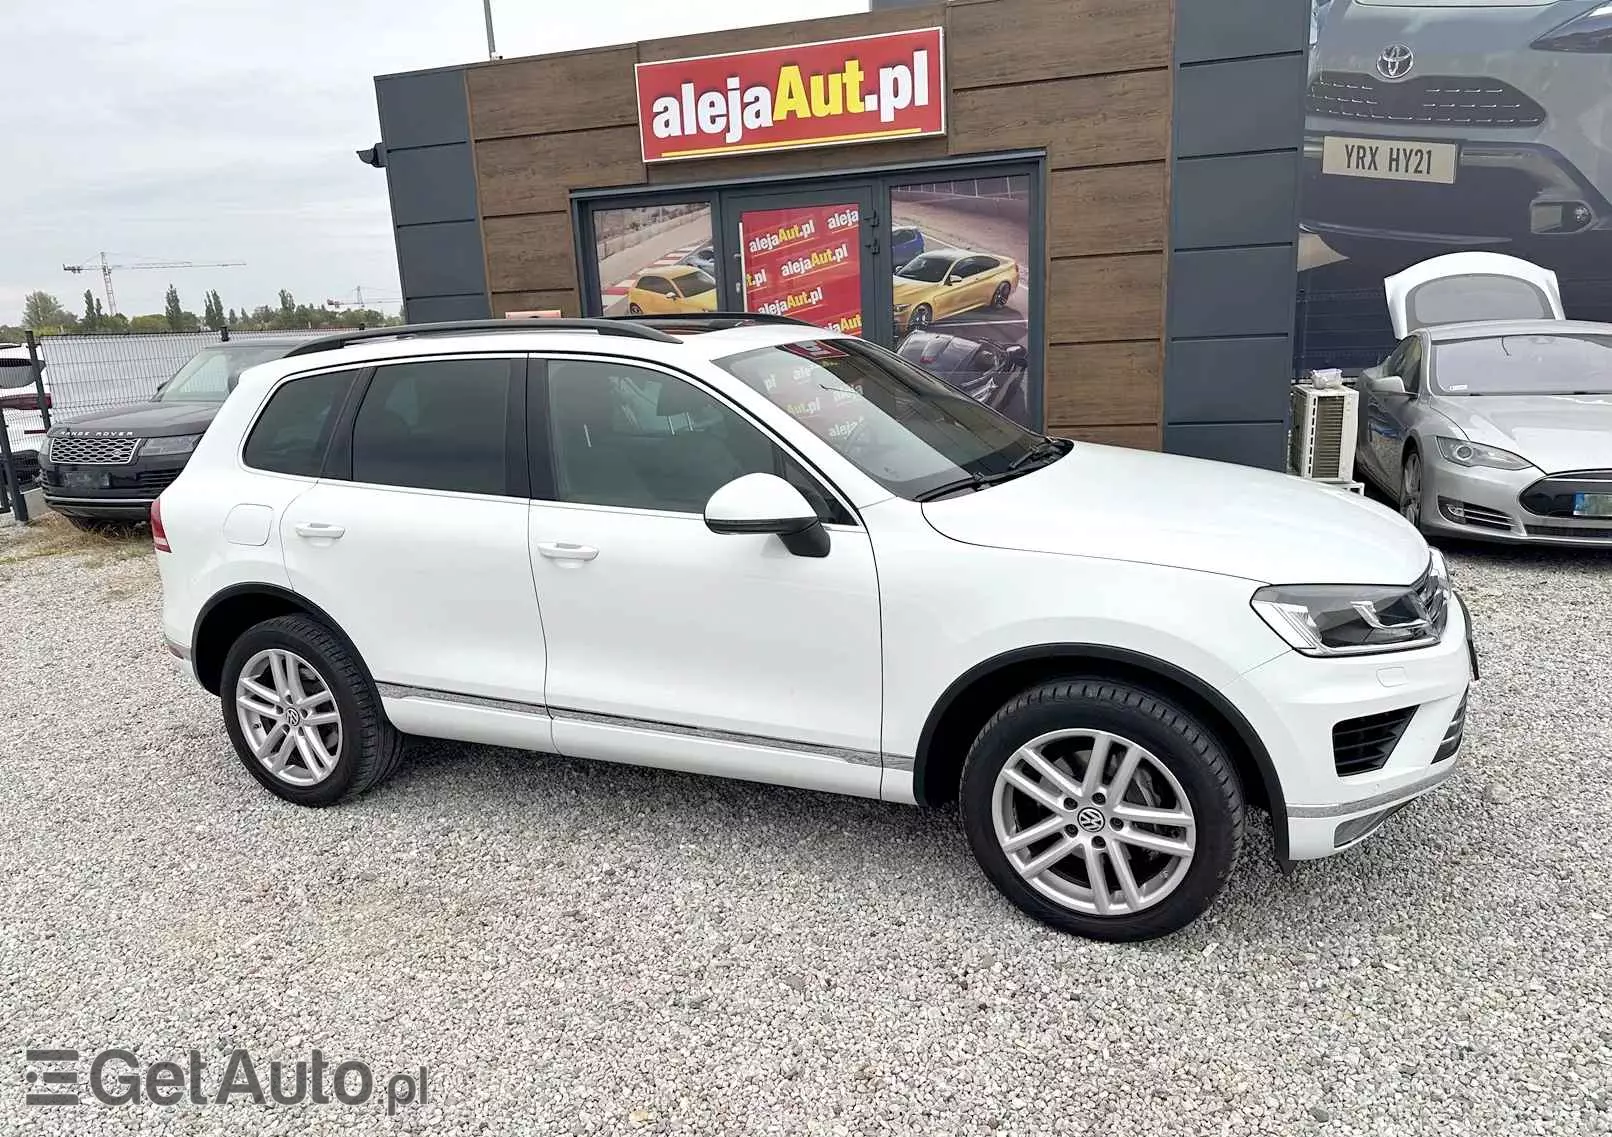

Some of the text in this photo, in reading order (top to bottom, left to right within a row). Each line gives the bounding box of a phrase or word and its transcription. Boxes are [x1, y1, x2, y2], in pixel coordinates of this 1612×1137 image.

[652, 50, 929, 143] alejaAut.pl
[1345, 144, 1432, 175] YRX HY21
[749, 219, 815, 252] alejaAut.pl
[781, 243, 848, 277] alejaAut.pl
